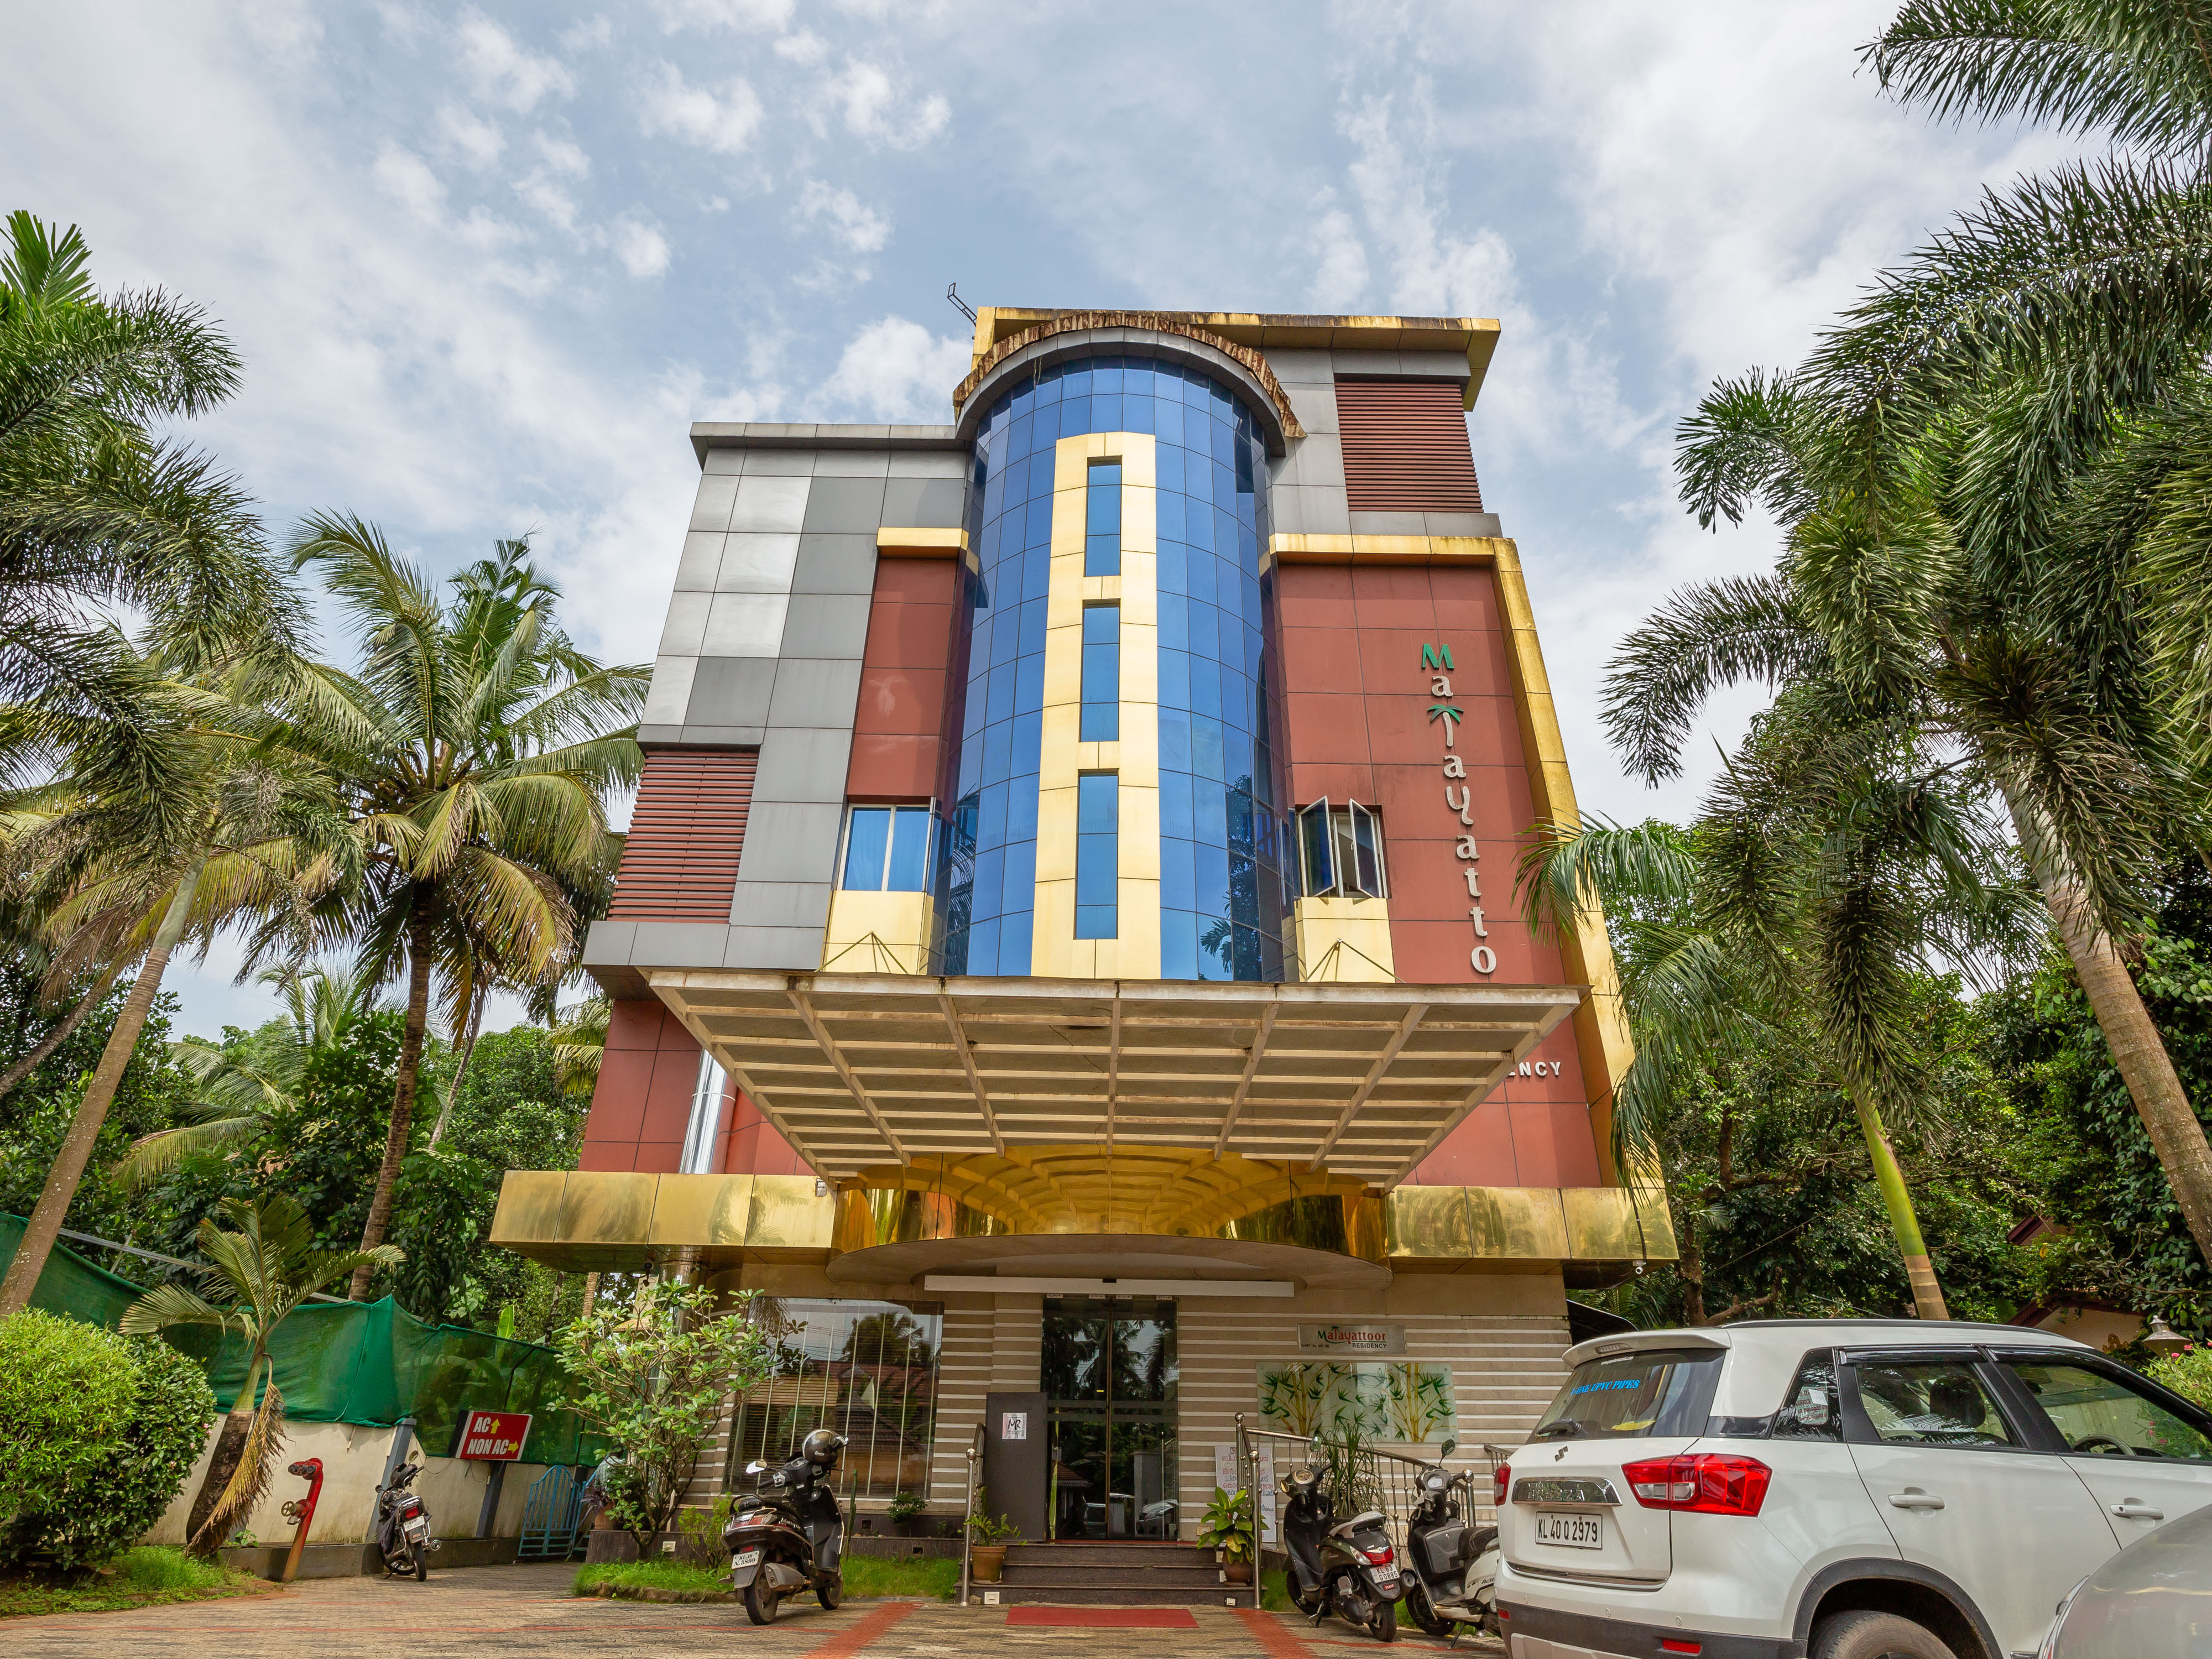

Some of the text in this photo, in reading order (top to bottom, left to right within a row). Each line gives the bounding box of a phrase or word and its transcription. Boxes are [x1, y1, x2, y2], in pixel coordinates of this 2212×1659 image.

[1509, 1061, 1561, 1076] NCY
[1317, 1326, 1386, 1344] Malayattoor
[1590, 1381, 1614, 1392] UPVC
[1611, 1380, 1641, 1390] PIPES
[473, 1417, 491, 1433] AC
[1008, 1418, 1021, 1430] MR
[466, 1439, 509, 1455] NON AC
[1538, 1519, 1598, 1542] KL 40 Q 2979
[1379, 1571, 1398, 1581] G0885
